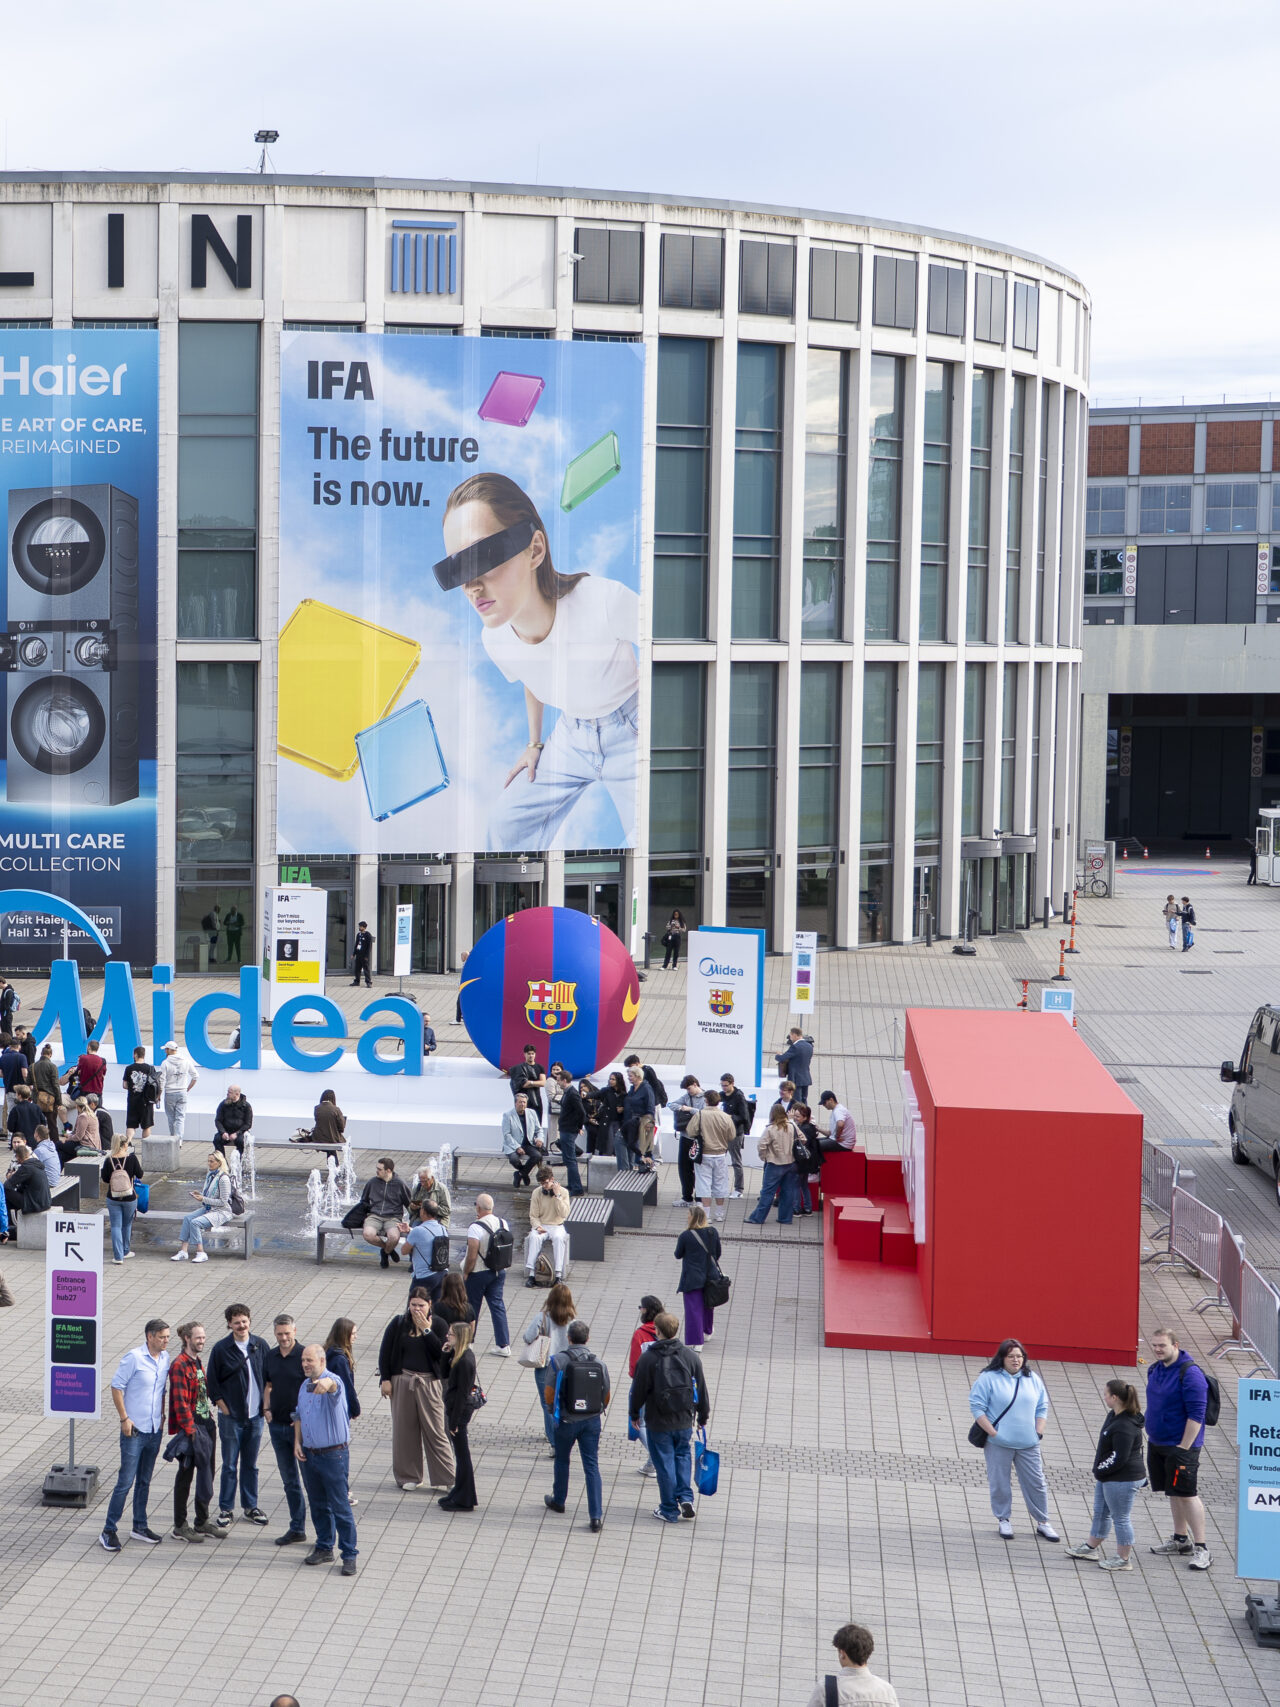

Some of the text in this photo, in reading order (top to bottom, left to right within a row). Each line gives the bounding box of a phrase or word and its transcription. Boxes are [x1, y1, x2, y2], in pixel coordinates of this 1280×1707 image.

[307, 360, 375, 401] IFA
[17, 418, 56, 432] ART
[60, 418, 87, 432] OF
[91, 418, 147, 435] CARE,
[2, 439, 121, 454] REIMAGINED
[307, 426, 480, 463] The future
[312, 472, 431, 508] is now.
[66, 833, 126, 849] CARE
[0, 857, 121, 872] COLLECTION
[521, 865, 527, 873] B
[281, 866, 311, 884] IFA
[424, 867, 431, 875] B
[7, 915, 33, 924] Visit
[35, 915, 65, 924] Haier
[7, 928, 30, 937] Hall
[33, 928, 47, 937] 3.1
[541, 1002, 561, 1010] FCB
[20, 955, 424, 1077] Midea
[712, 1021, 735, 1029] PARTNER
[55, 1221, 75, 1233] IFA
[56, 1275, 85, 1283] Entrance
[56, 1284, 86, 1292] Eingang
[55, 1371, 77, 1379] Global
[55, 1380, 82, 1388] Markets
[1249, 1389, 1272, 1401] IFA
